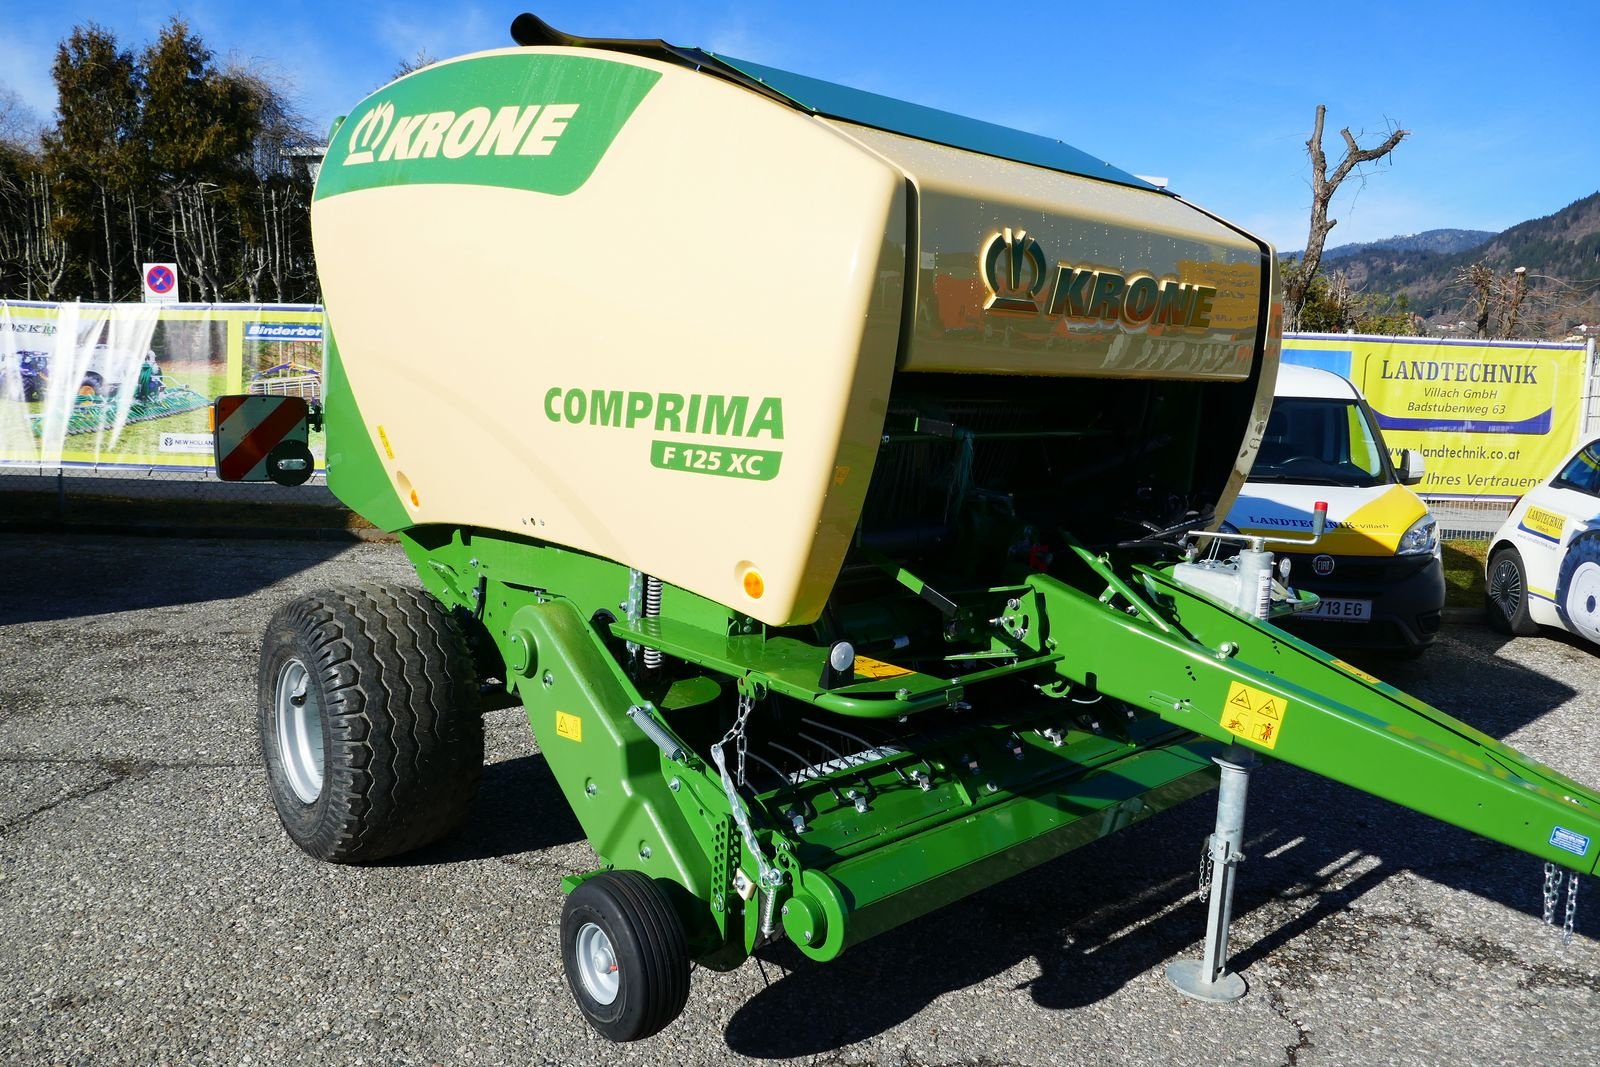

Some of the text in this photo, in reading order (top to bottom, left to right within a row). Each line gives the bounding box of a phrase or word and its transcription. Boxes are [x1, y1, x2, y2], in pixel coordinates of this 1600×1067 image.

[378, 104, 580, 161] KRONE
[1048, 265, 1217, 326] KRONE
[1381, 360, 1538, 384] LANDTECHNIK
[1424, 387, 1497, 399] Villach GmbH
[544, 387, 784, 440] COMPRIMA
[1407, 401, 1506, 416] Badstubenweg 63
[663, 447, 764, 475] F 125 XC
[1426, 472, 1461, 486] Ihres
[1248, 516, 1355, 529] LANDTENIK
[1344, 602, 1362, 616] EG
